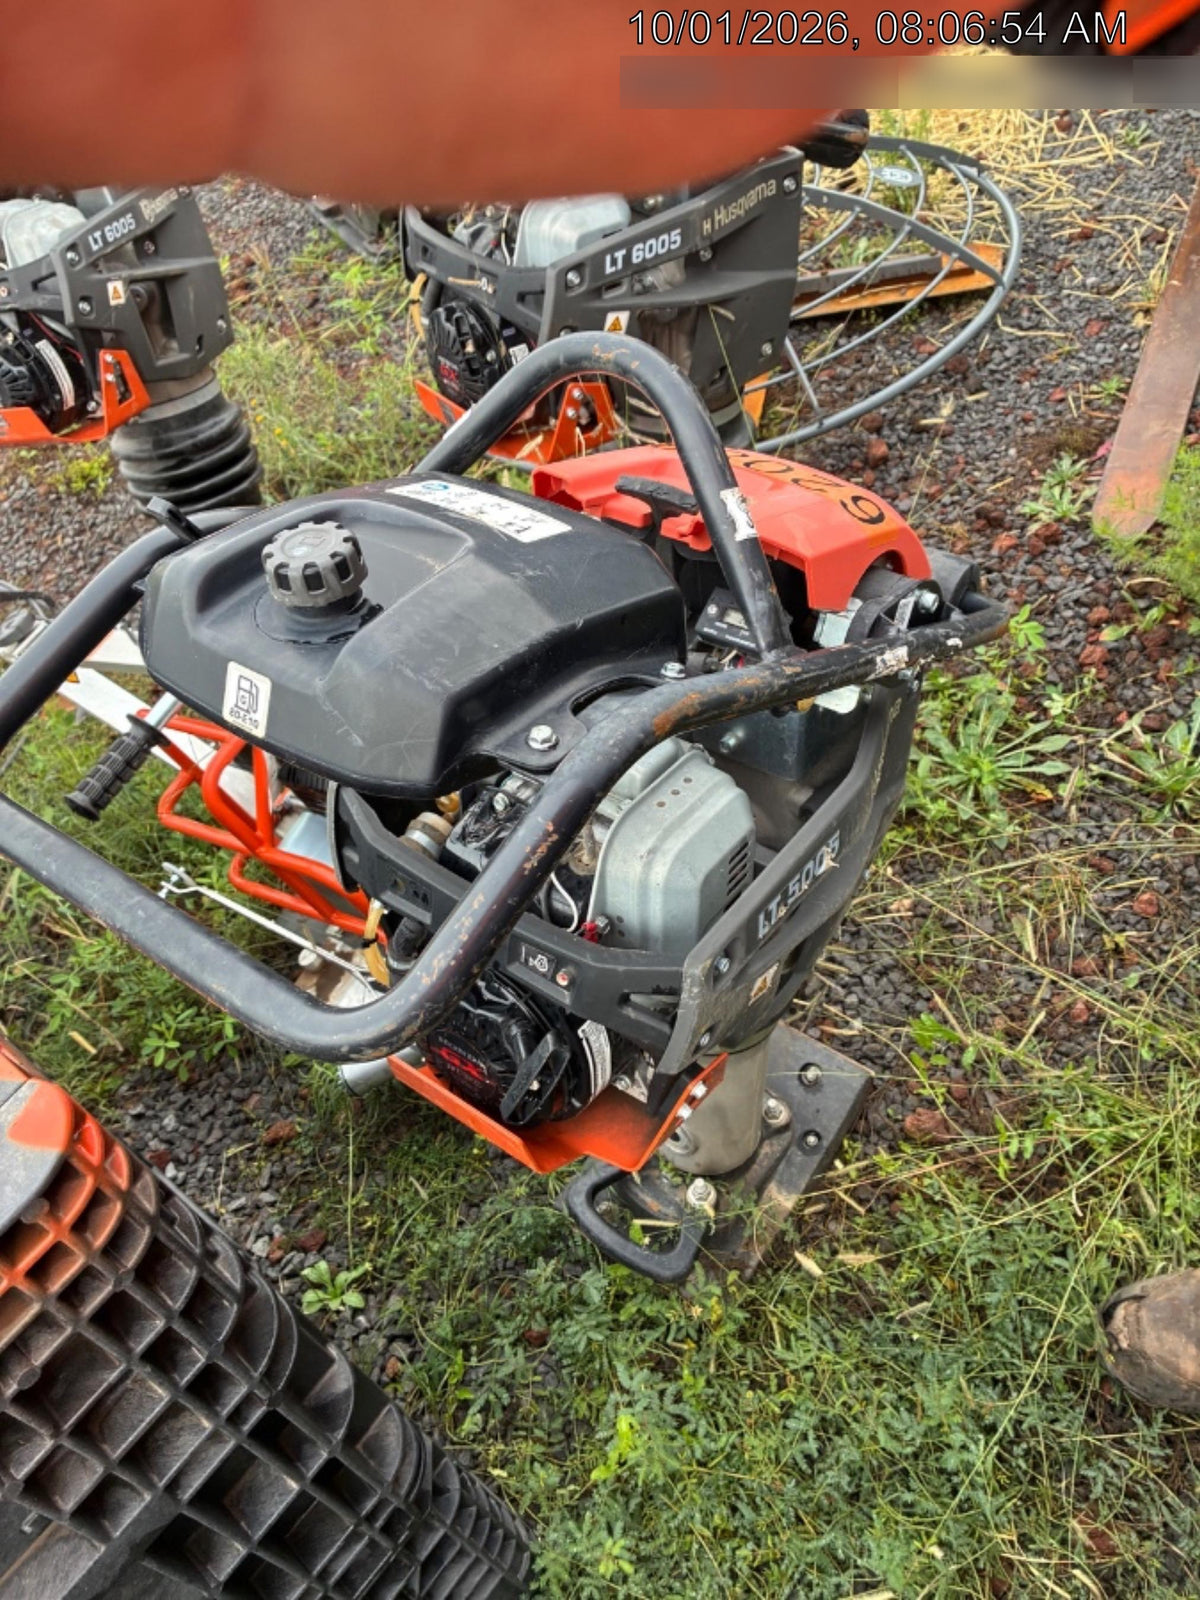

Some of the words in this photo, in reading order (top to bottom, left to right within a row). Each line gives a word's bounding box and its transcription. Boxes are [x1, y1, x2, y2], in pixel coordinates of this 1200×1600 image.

[714, 178, 777, 229] Husqvarna
[88, 229, 105, 252] LT
[105, 213, 137, 244] 6005
[604, 247, 628, 276] LT
[630, 228, 683, 265] 6005
